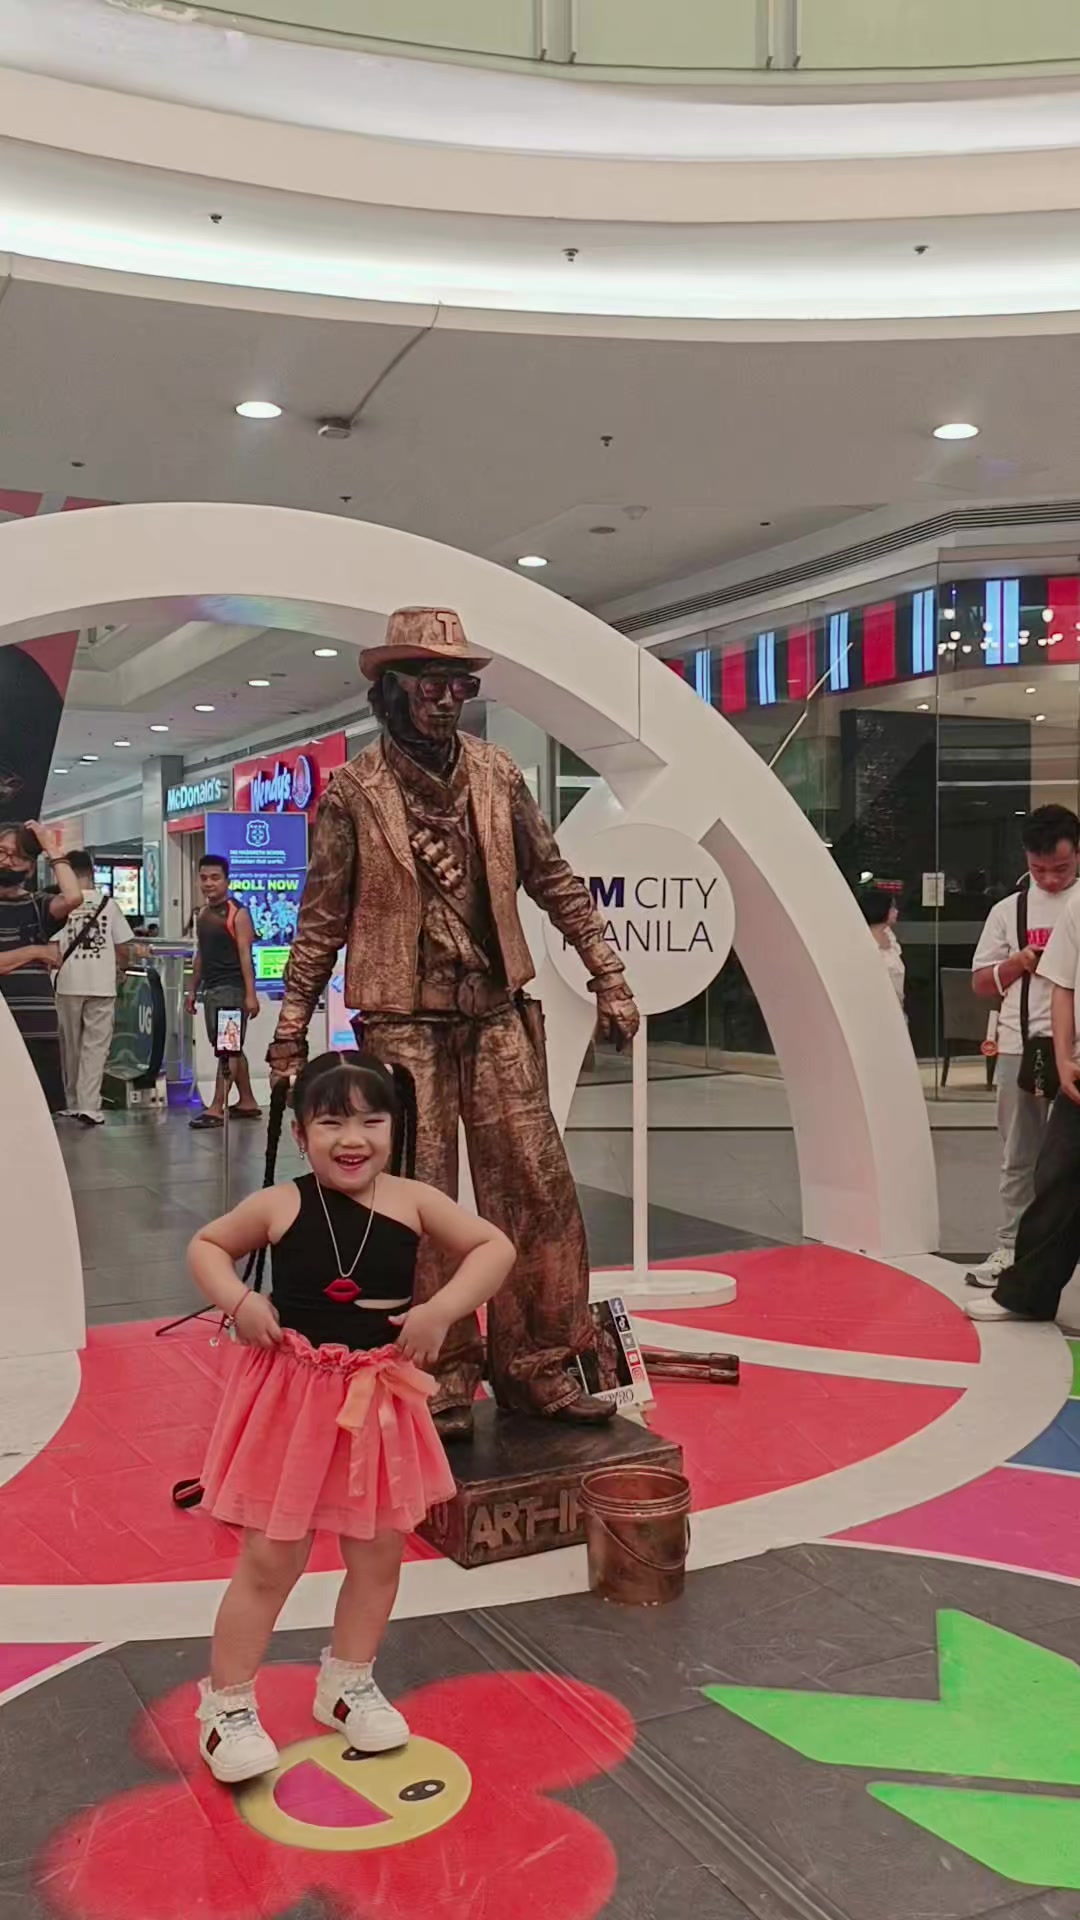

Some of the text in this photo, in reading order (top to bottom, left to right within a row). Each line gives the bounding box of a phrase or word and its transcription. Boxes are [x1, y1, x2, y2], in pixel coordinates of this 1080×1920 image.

[167, 777, 221, 812] McDonald's
[250, 761, 292, 812] Wendy's
[228, 879, 299, 891] NROLL NOW
[573, 876, 717, 909] M CITY
[563, 920, 714, 952] ANILA
[138, 1004, 152, 1035] UG
